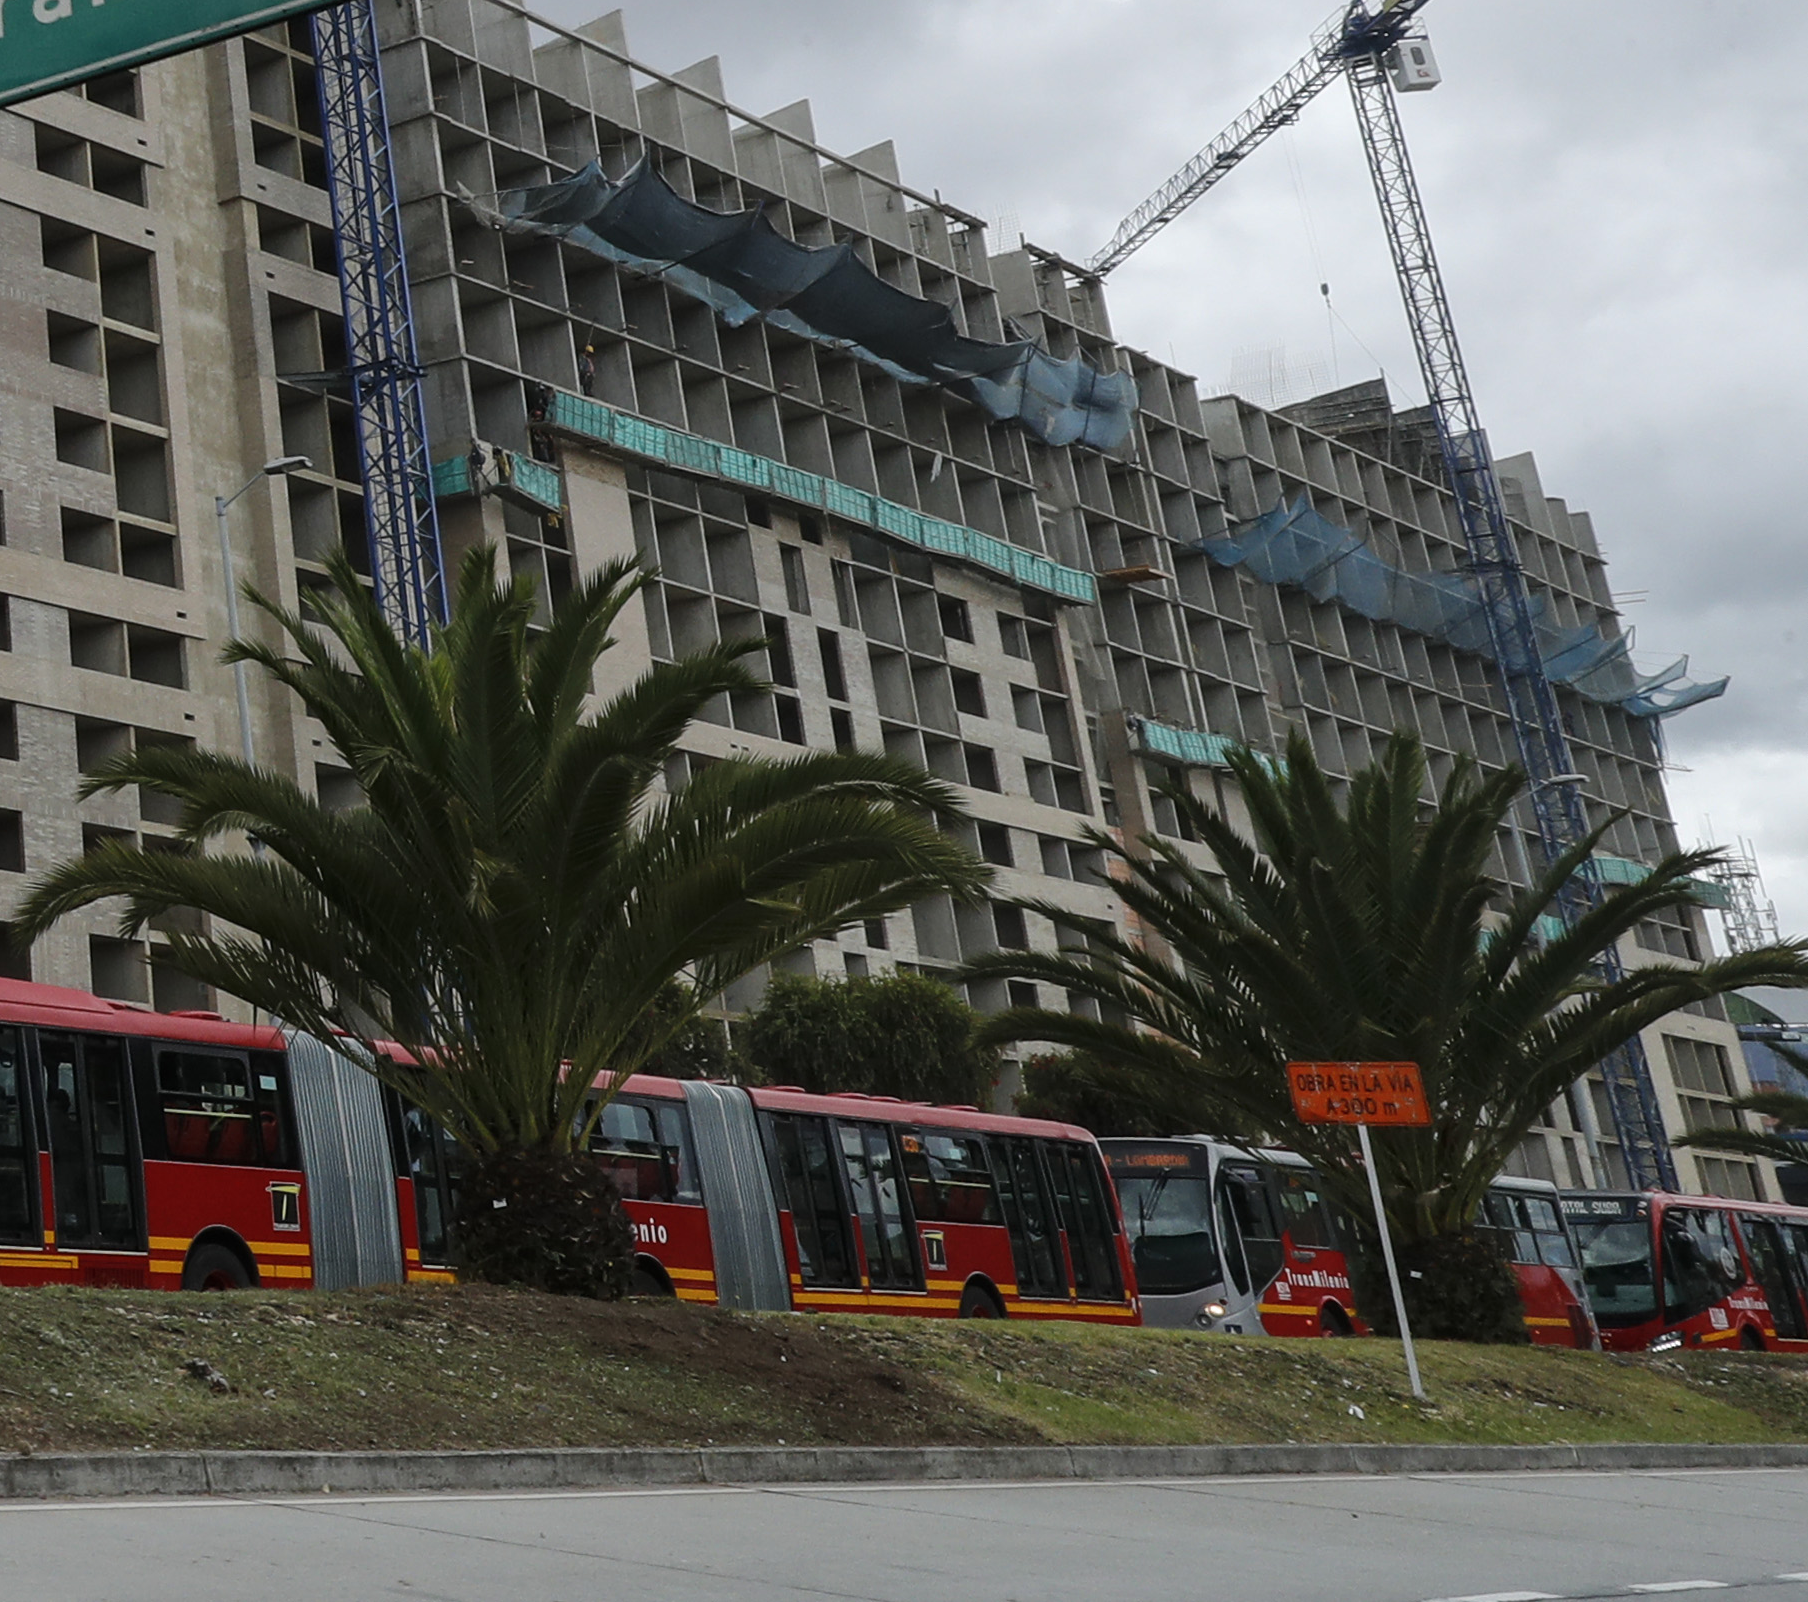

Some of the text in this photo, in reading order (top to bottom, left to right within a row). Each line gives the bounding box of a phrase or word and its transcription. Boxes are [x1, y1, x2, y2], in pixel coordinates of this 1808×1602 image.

[1296, 1073, 1337, 1094] OBRA
[1340, 1074, 1360, 1093] EN
[1362, 1073, 1383, 1093] LA
[1340, 1098, 1378, 1116] 300
